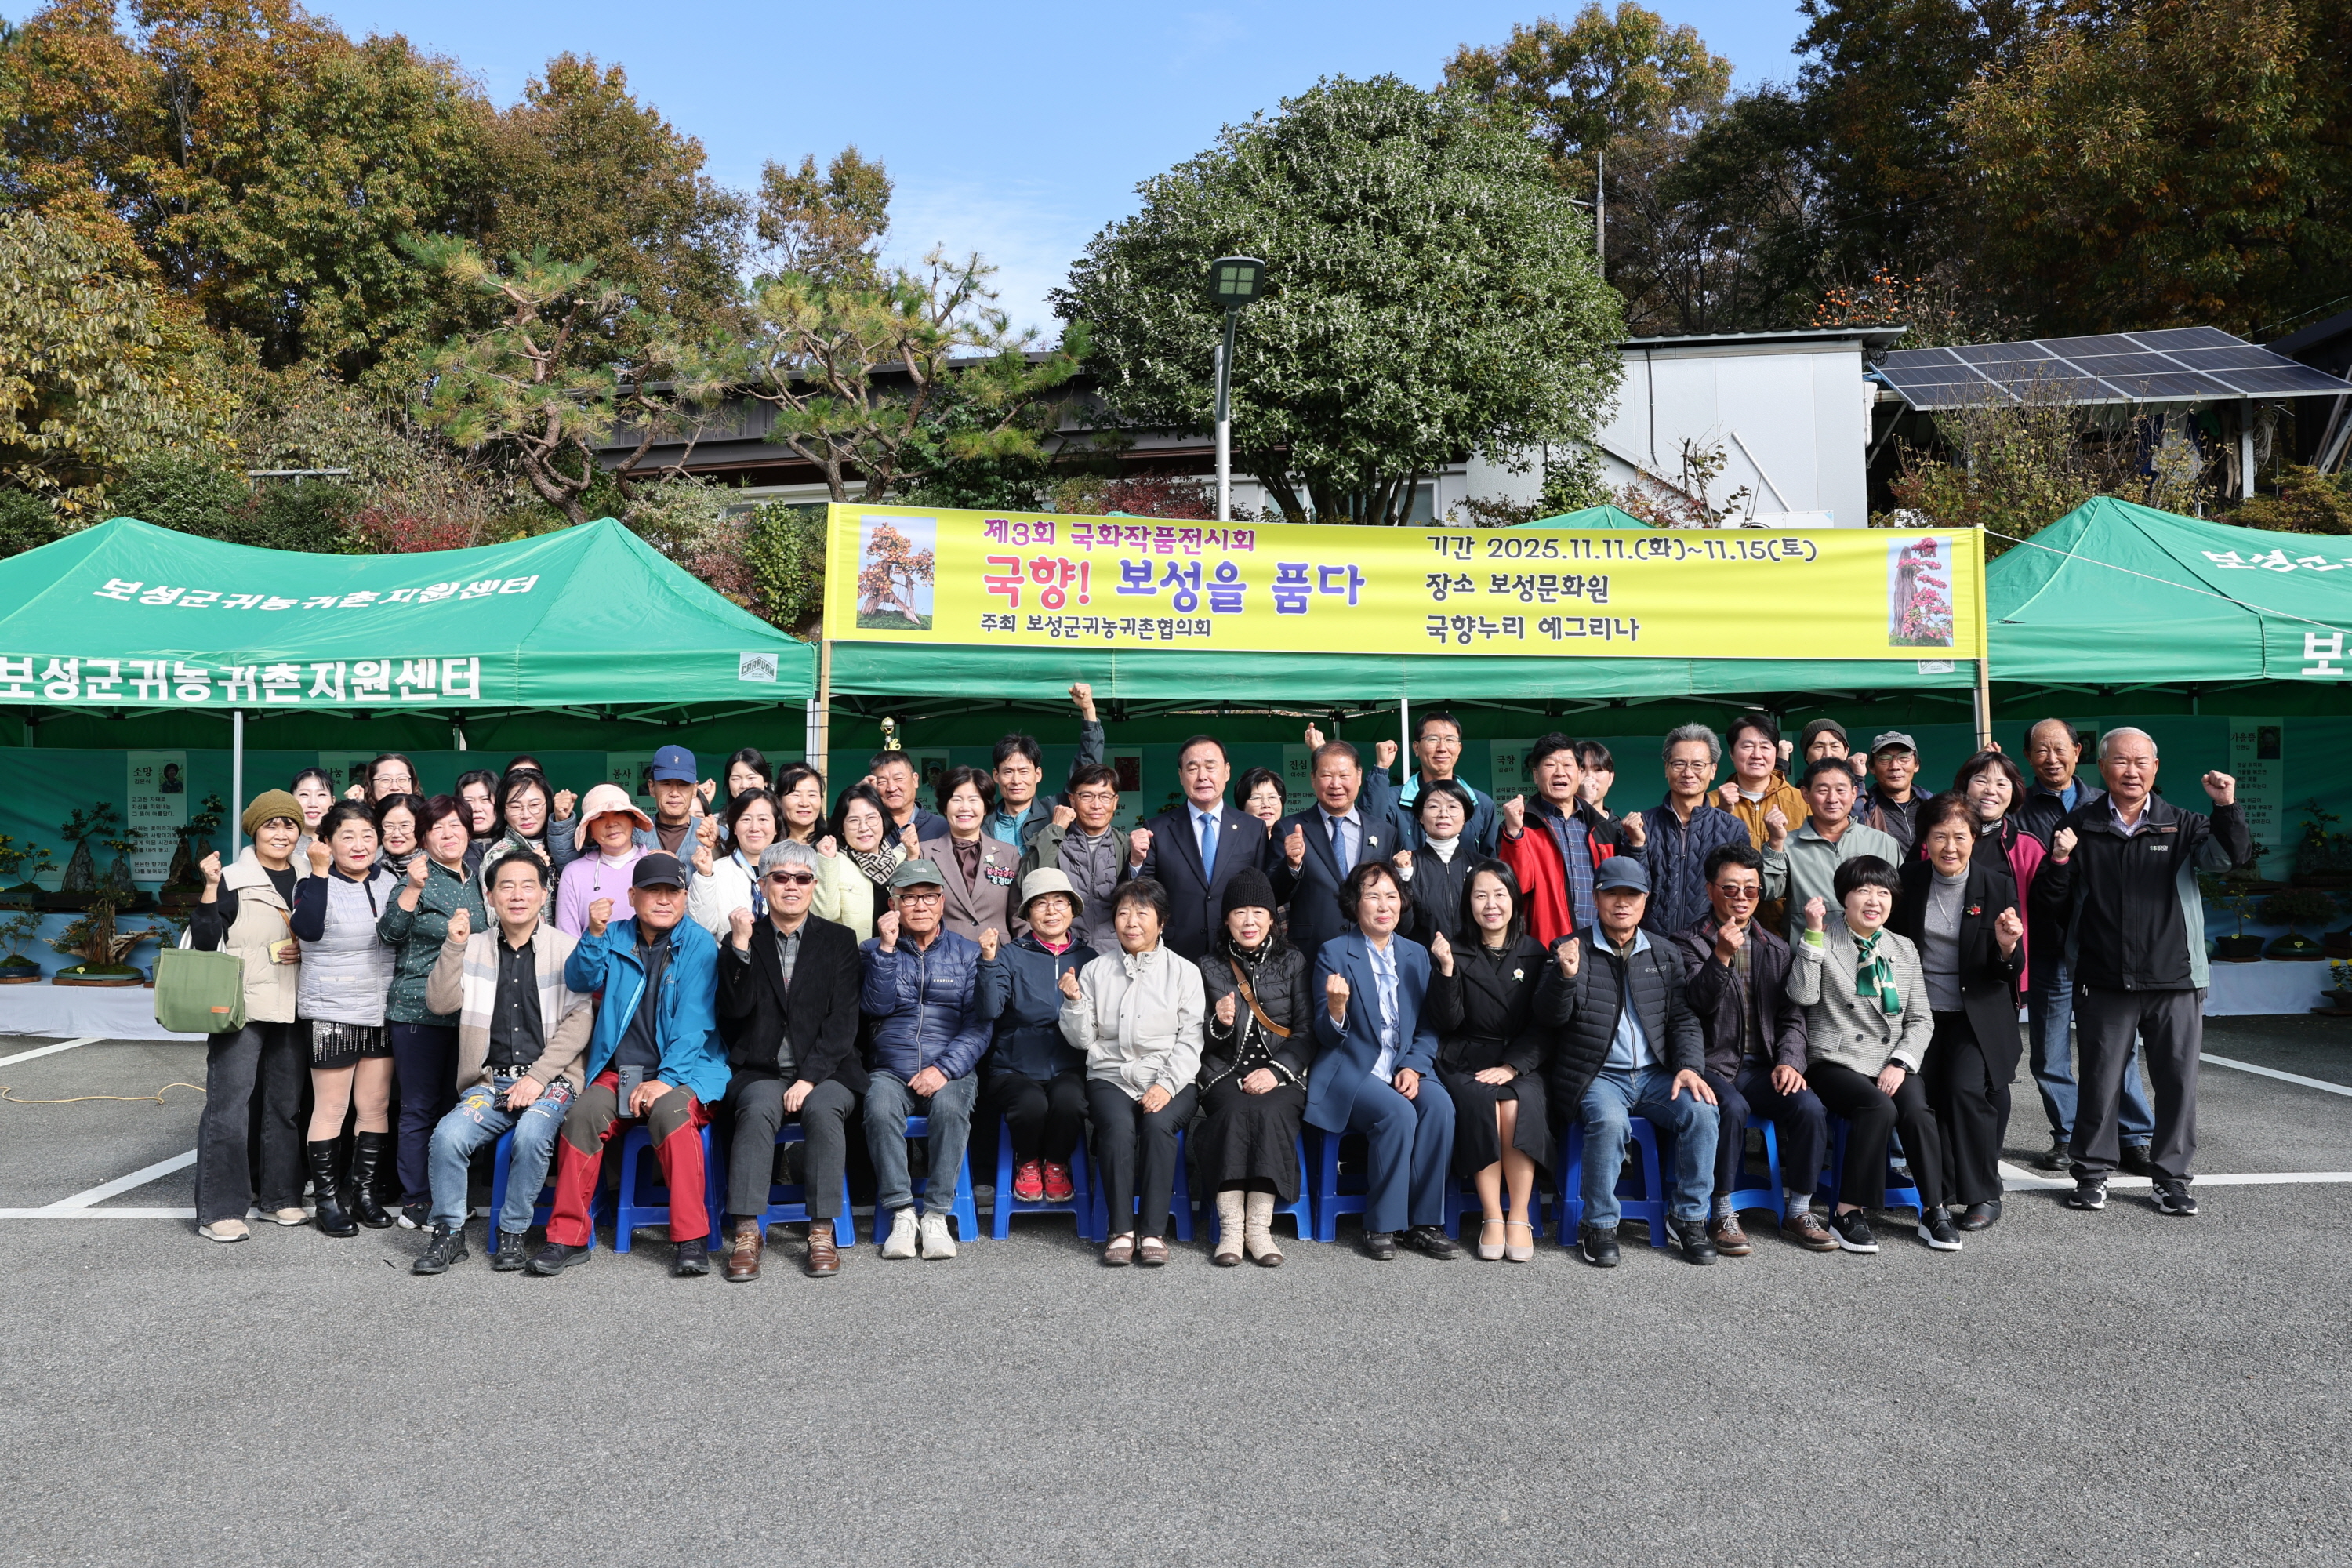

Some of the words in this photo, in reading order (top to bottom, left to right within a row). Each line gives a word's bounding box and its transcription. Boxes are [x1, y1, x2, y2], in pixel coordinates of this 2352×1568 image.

[984, 518, 1056, 546] 제3회
[1071, 522, 1256, 554] 국화작품전시회
[1426, 535, 1475, 561] 기간
[1487, 536, 1817, 563] 2025.11.11.(화)~11.15(토)
[2201, 549, 2352, 572] 보성군
[93, 575, 539, 611] 보성군귀농귀촌지원센터
[982, 554, 1091, 611] 국향!
[1116, 559, 1247, 615] 보성을
[1271, 562, 1366, 615] 품다
[1425, 572, 1475, 601] 장소
[1488, 572, 1609, 604] 보성문화원
[981, 614, 1016, 633] 주최
[1026, 615, 1211, 641] 보성군귀농귀촌협의회
[1425, 615, 1525, 644] 국향누리
[1538, 615, 1640, 642] 예그리나
[2301, 632, 2352, 675] 보
[0, 656, 481, 702] 보성군귀농귀촌지원센터
[741, 659, 775, 677] CARAVAN
[133, 767, 153, 777] 소망
[612, 768, 632, 779] 봉사
[1290, 759, 1308, 770] 진심
[1497, 754, 1516, 765] 국향
